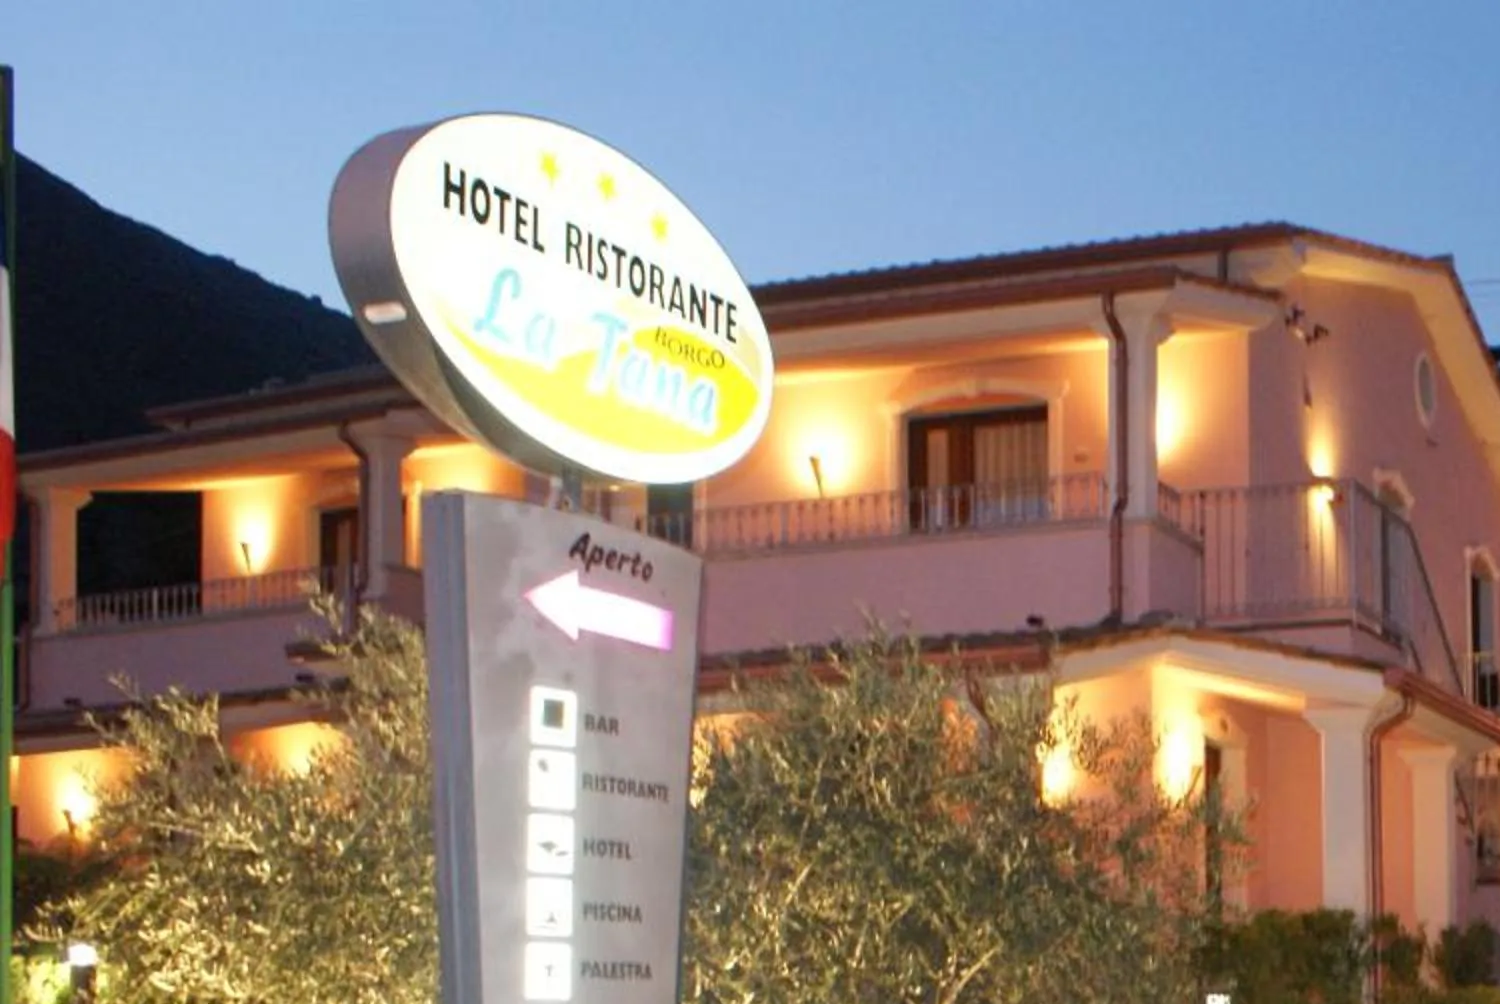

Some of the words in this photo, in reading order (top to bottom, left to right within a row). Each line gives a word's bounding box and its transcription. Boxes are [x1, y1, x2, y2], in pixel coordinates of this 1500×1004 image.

[443, 161, 546, 254] HOTEL
[564, 221, 738, 344] RISTORANTE
[473, 266, 558, 361] La
[590, 311, 717, 426] Tana
[653, 325, 726, 371] BORGO
[568, 532, 654, 582] Aperto
[584, 713, 620, 737] BAR
[582, 773, 670, 804] RISTORANTE
[583, 838, 634, 861] HOTEL
[582, 903, 643, 924] PISCINA
[580, 961, 653, 981] PALESTRA
